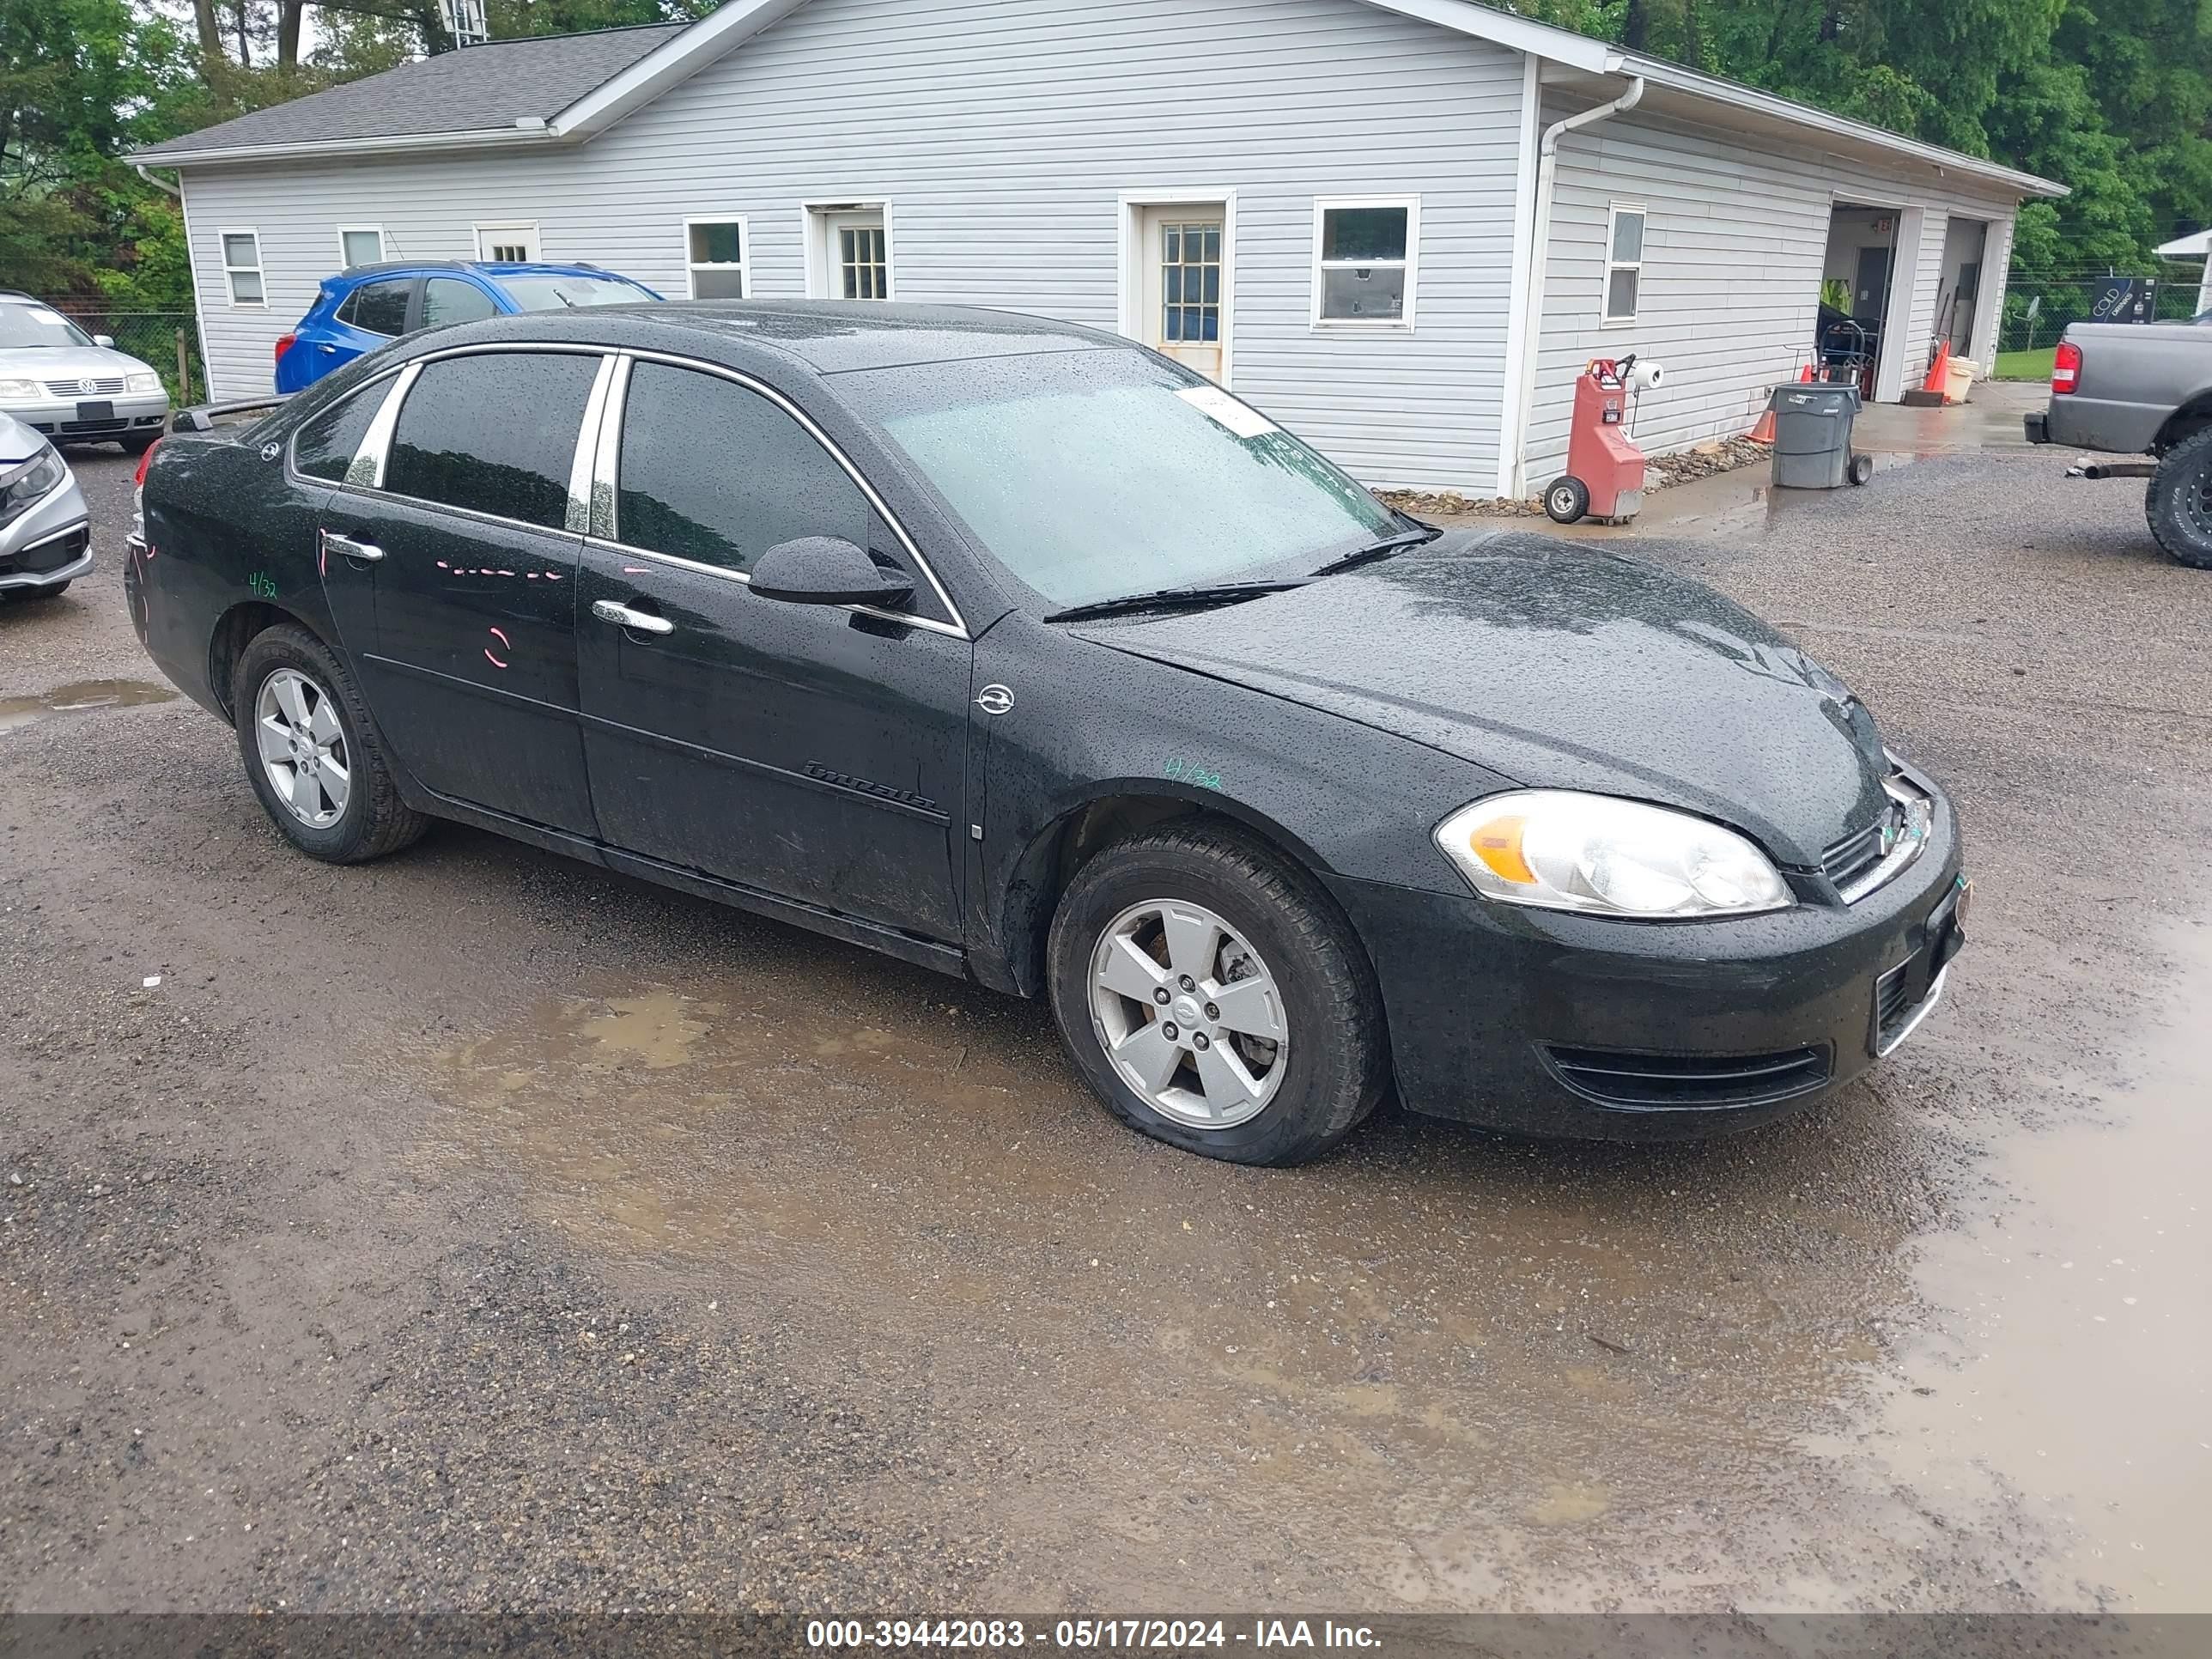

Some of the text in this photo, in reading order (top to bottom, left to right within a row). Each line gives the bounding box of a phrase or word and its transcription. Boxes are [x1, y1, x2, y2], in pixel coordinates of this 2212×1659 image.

[2094, 289, 2119, 317] COLD
[2112, 293, 2133, 316] DRINKS
[249, 571, 277, 600] 4/32
[1166, 757, 1221, 789] 4/32
